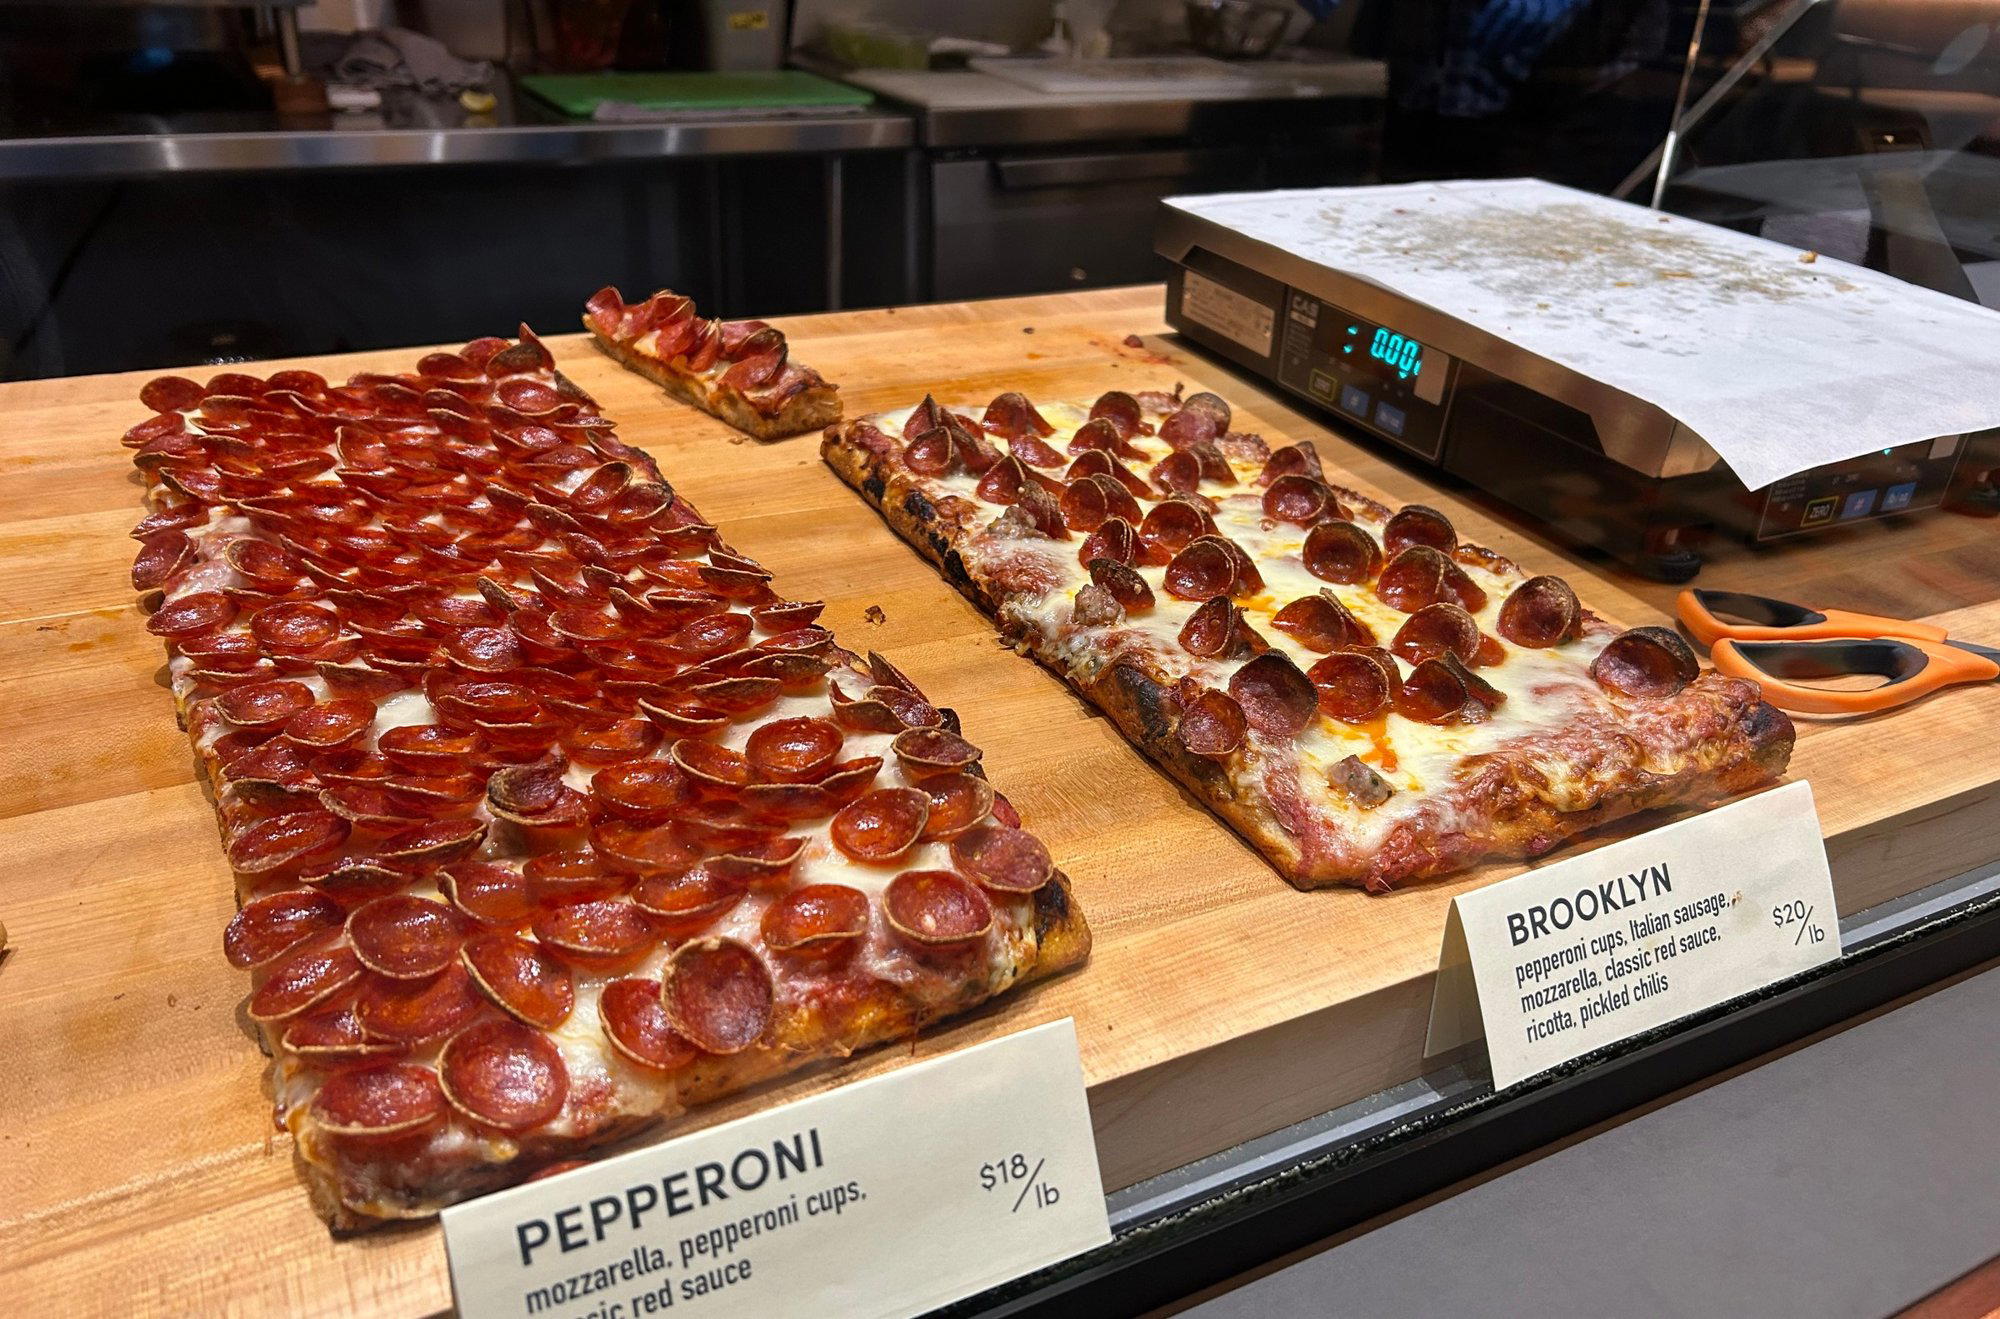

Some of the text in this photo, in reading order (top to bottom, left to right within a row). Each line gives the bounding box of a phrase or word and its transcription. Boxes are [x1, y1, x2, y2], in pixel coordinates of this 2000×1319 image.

[1507, 863, 1672, 946] BROOKLYN
[1515, 893, 1730, 989] pepperoni cups, Italian sausage,
[1521, 926, 1721, 1013] mozzarella, classic red sauce,
[1526, 972, 1669, 1043] ricotta, pickled chilis
[516, 1128, 824, 1267] PEPPERONI
[679, 1194, 799, 1269] pepperoni
[631, 1278, 674, 1318] red
[681, 1258, 752, 1300] sauce
